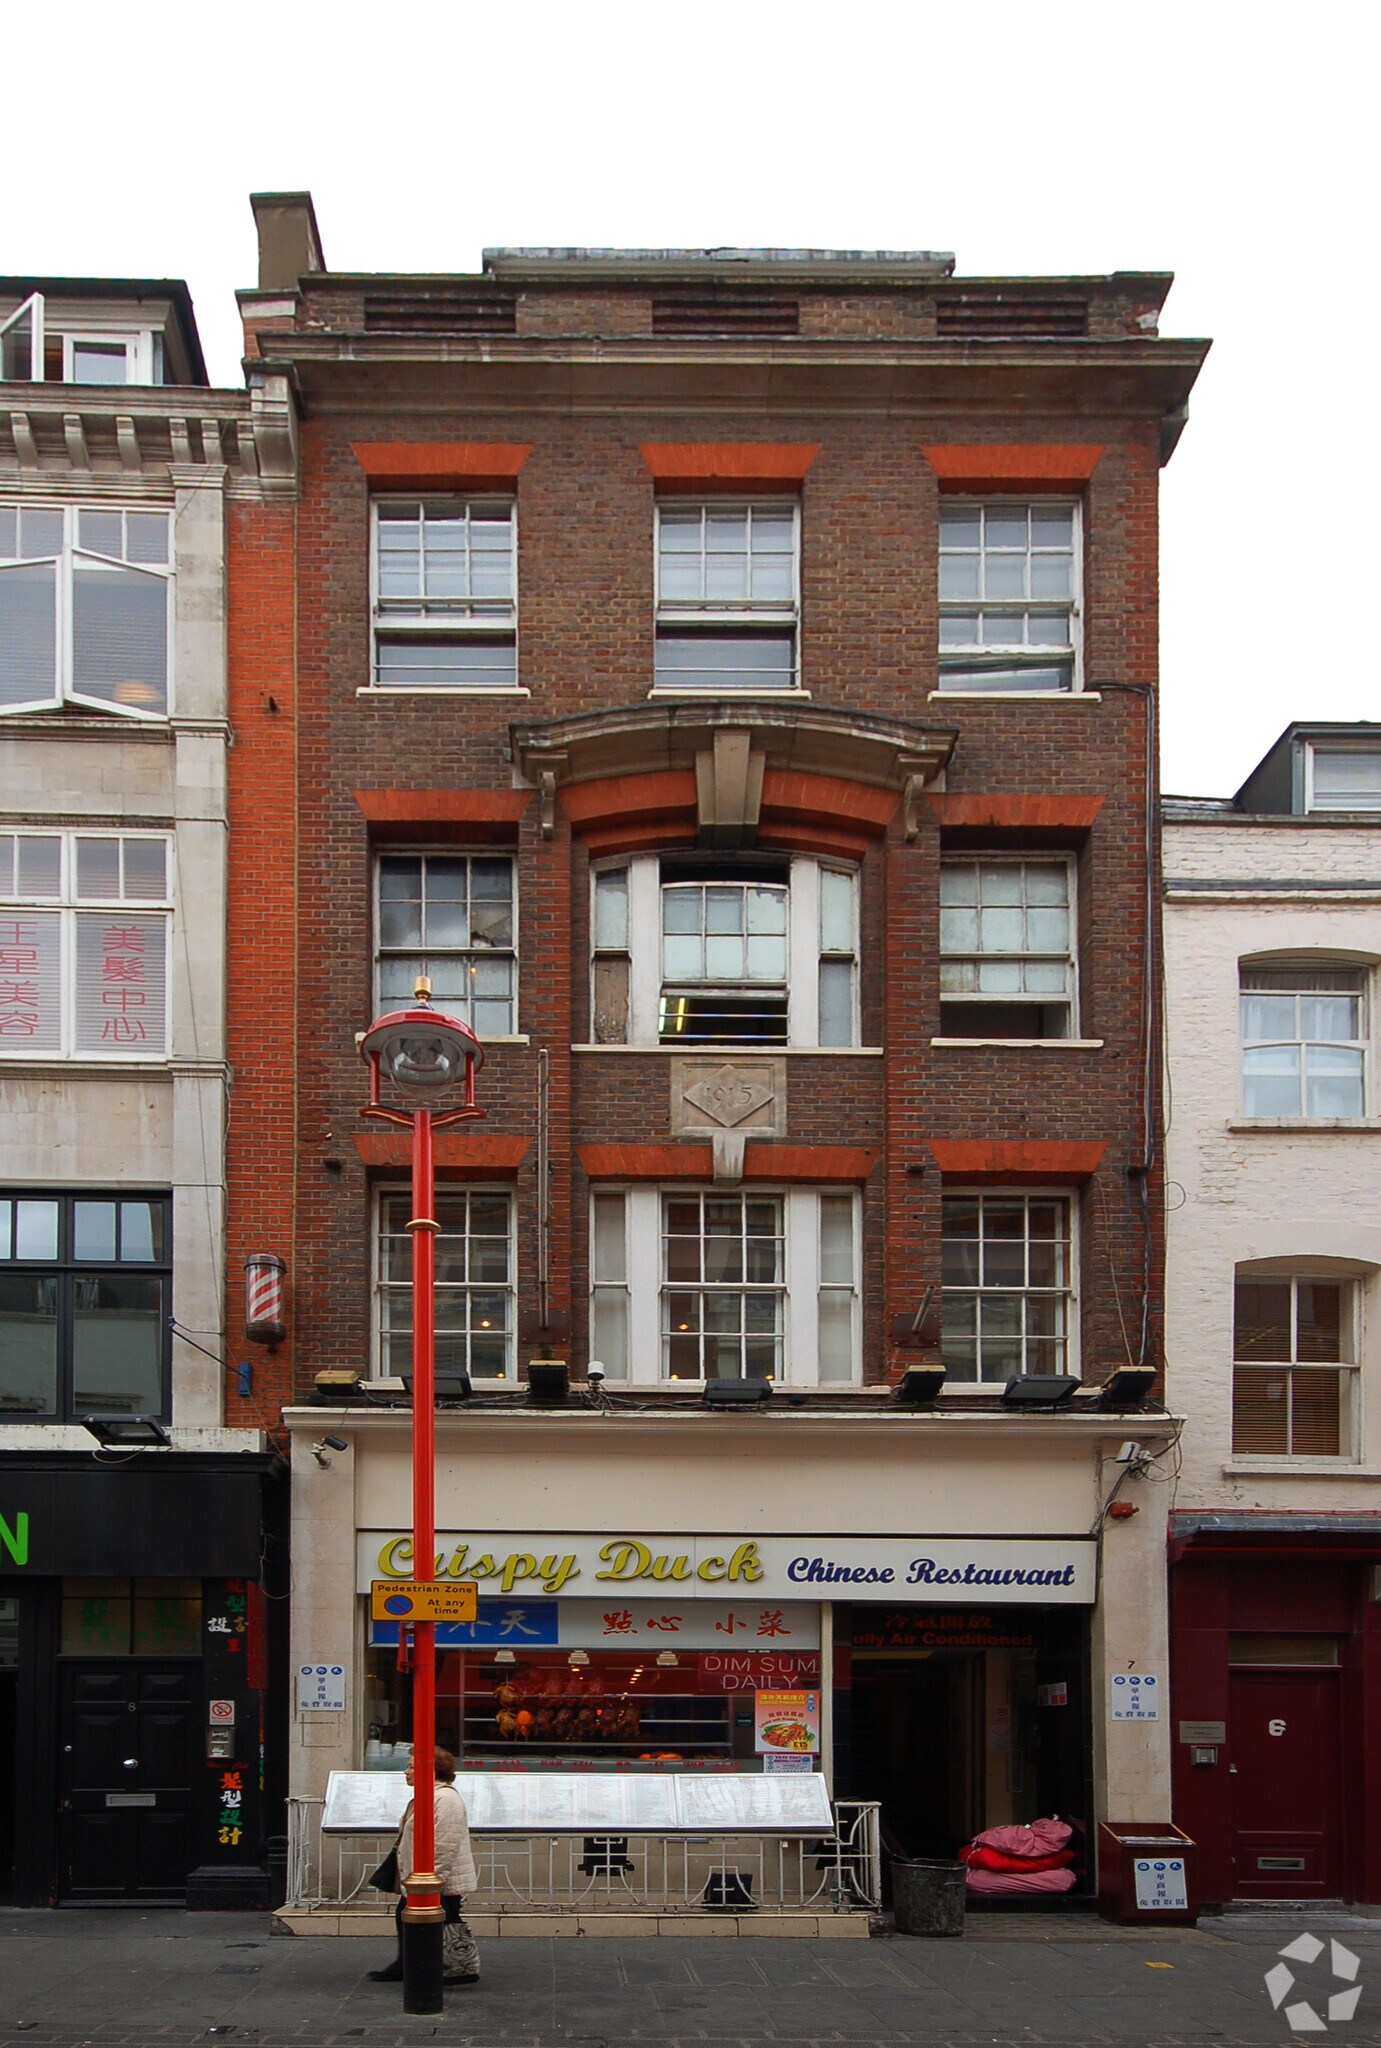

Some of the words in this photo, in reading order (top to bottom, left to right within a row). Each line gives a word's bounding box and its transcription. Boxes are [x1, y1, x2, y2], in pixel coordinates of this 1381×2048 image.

[102, 925, 146, 1042] 美髮中心
[705, 1086, 753, 1112] 1915
[595, 1539, 765, 1582] Duck
[787, 1557, 895, 1583] Chinese
[906, 1558, 1075, 1586] Restaurant
[377, 1584, 440, 1593] Pedestrian
[445, 1585, 473, 1594] Zone
[447, 1600, 465, 1608] any
[602, 1609, 682, 1635] 點心
[715, 1609, 792, 1637] 小菜
[853, 1633, 885, 1648] ully
[890, 1634, 916, 1646] Air
[921, 1632, 1032, 1646] Conditioned
[704, 1656, 751, 1672] DIM
[760, 1657, 817, 1673] SUM
[1127, 1660, 1136, 1670] 7
[722, 1674, 798, 1690] DAILY
[1269, 1719, 1287, 1736] 6
[218, 1771, 244, 1845] 髮型設計
